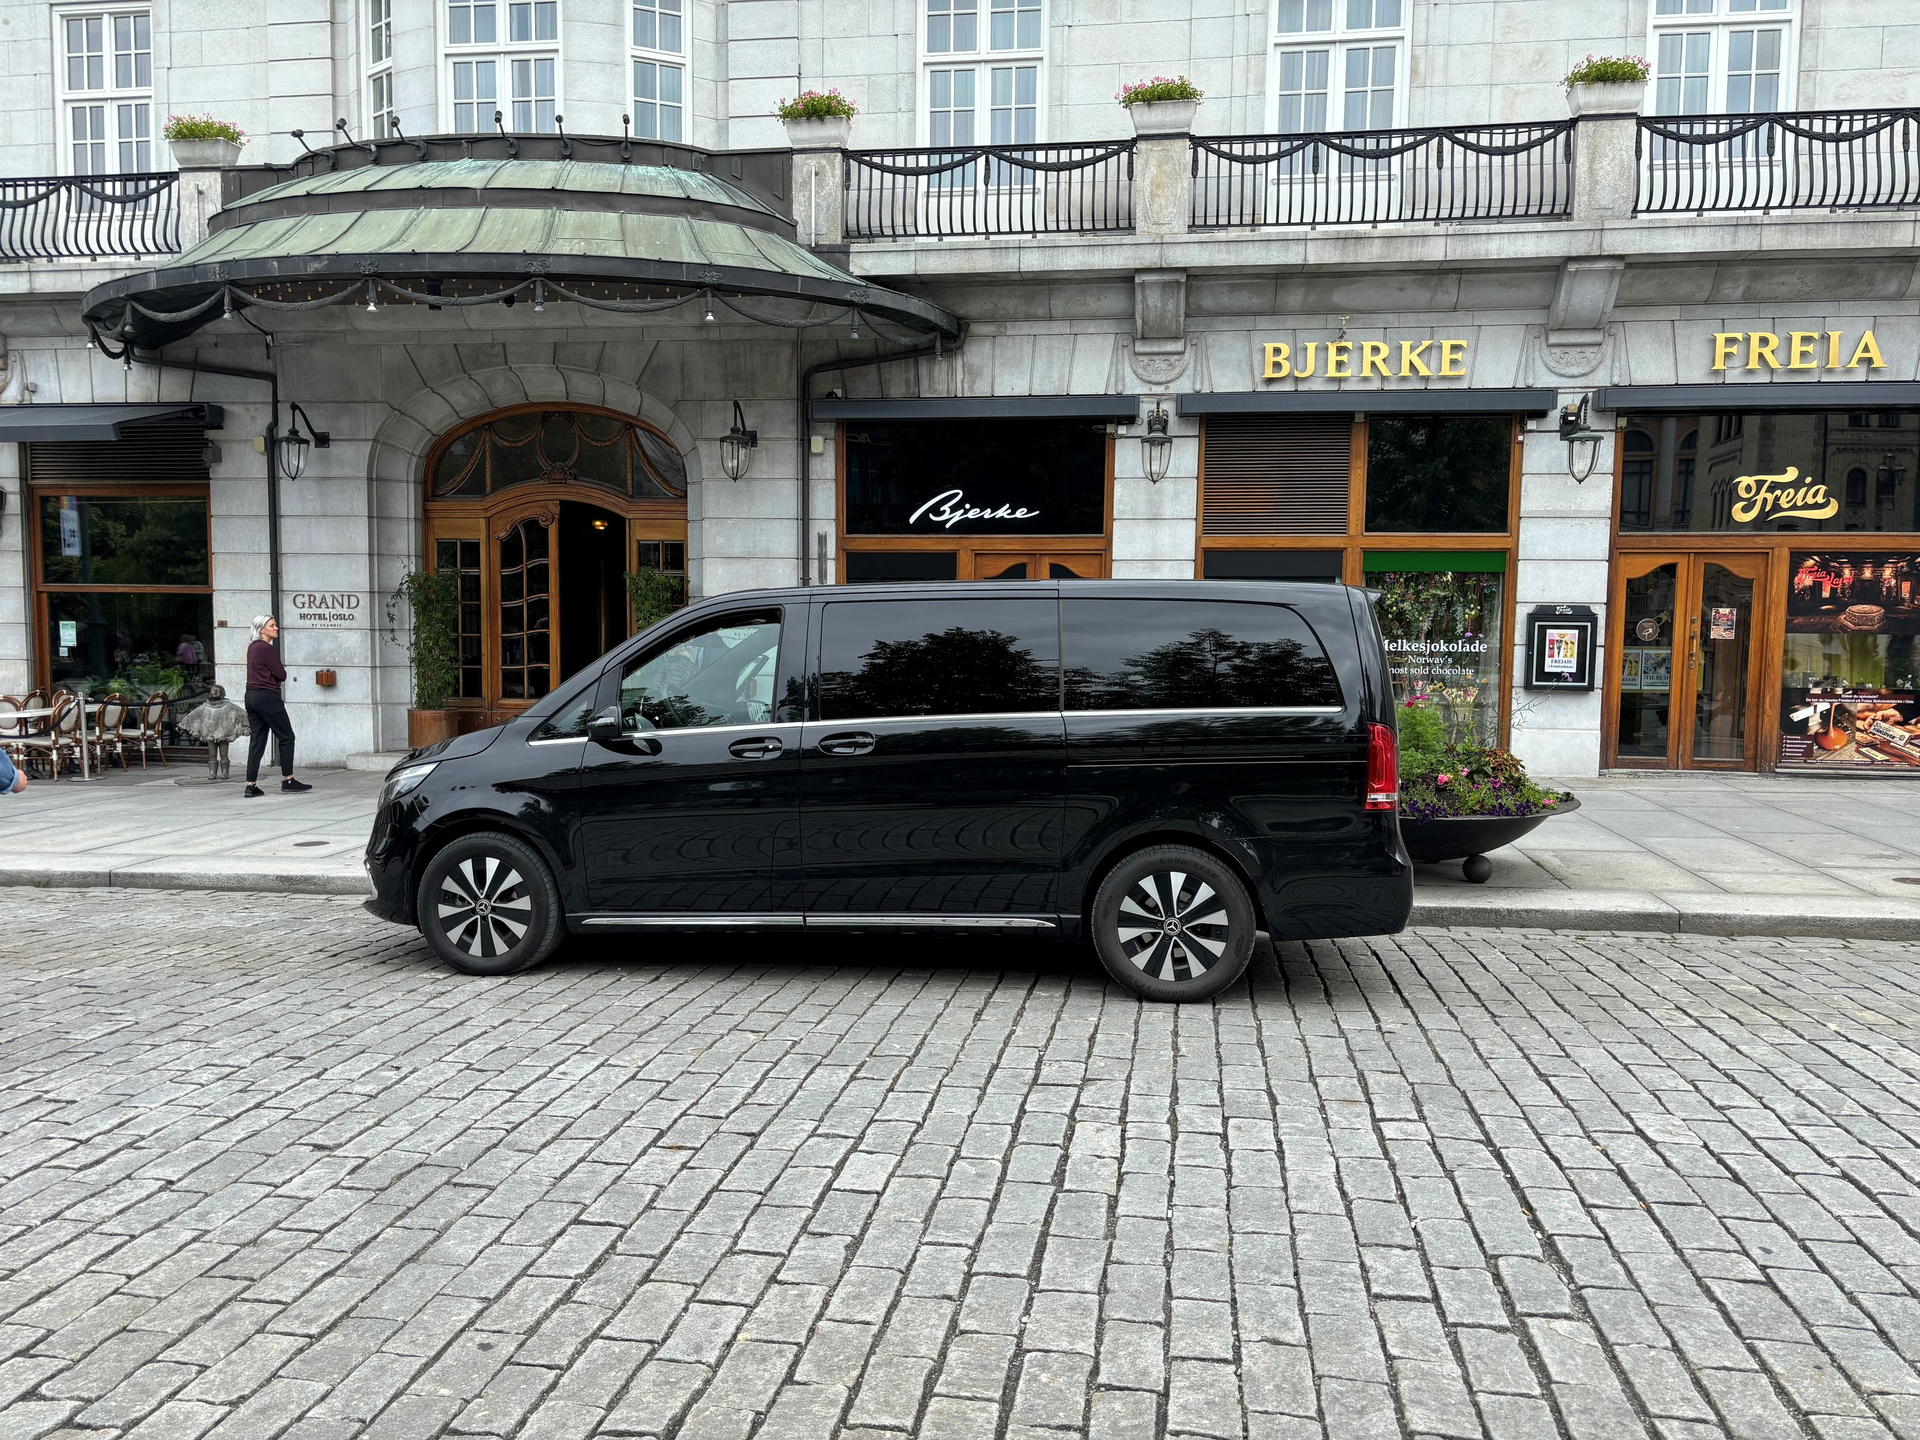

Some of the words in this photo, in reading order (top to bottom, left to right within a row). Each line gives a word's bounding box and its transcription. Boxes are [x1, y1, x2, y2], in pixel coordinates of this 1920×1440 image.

[1261, 340, 1468, 379] BJERKE
[1711, 330, 1888, 370] FREIA
[1731, 466, 1839, 523] Freia
[909, 489, 1040, 529] Bjerke
[292, 593, 360, 610] GRAND
[299, 612, 328, 621] HOTEL
[331, 613, 355, 621] OSLO
[1407, 655, 1453, 666] Norway's
[1410, 666, 1429, 675] sold
[1431, 666, 1475, 675] chocolate
